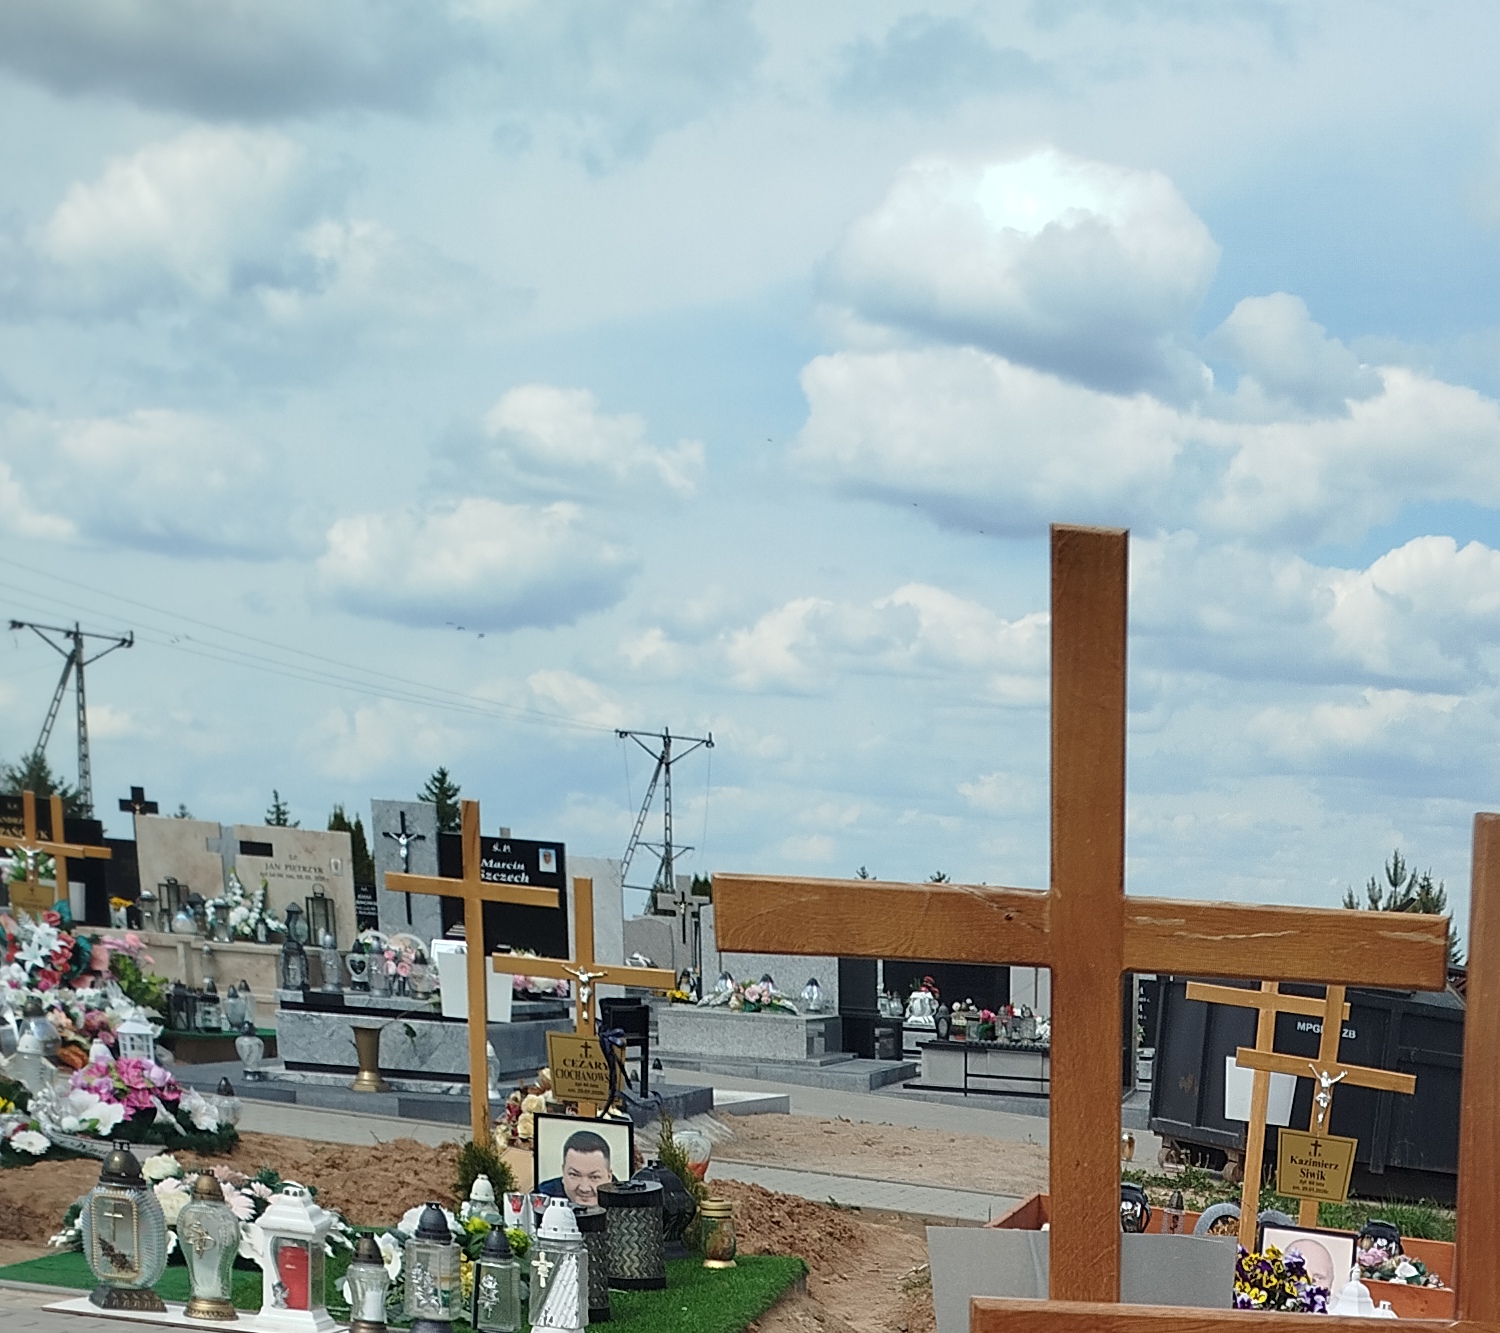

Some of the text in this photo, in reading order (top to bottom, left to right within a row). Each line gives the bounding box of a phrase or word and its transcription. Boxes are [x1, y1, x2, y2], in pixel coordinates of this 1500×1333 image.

[480, 858, 525, 871] Marcin
[562, 1058, 608, 1071] CEZARY
[555, 1069, 610, 1083] CIOCHANOWS
[1290, 1155, 1339, 1171] Kazimierz
[1299, 1168, 1326, 1181] Siwik
